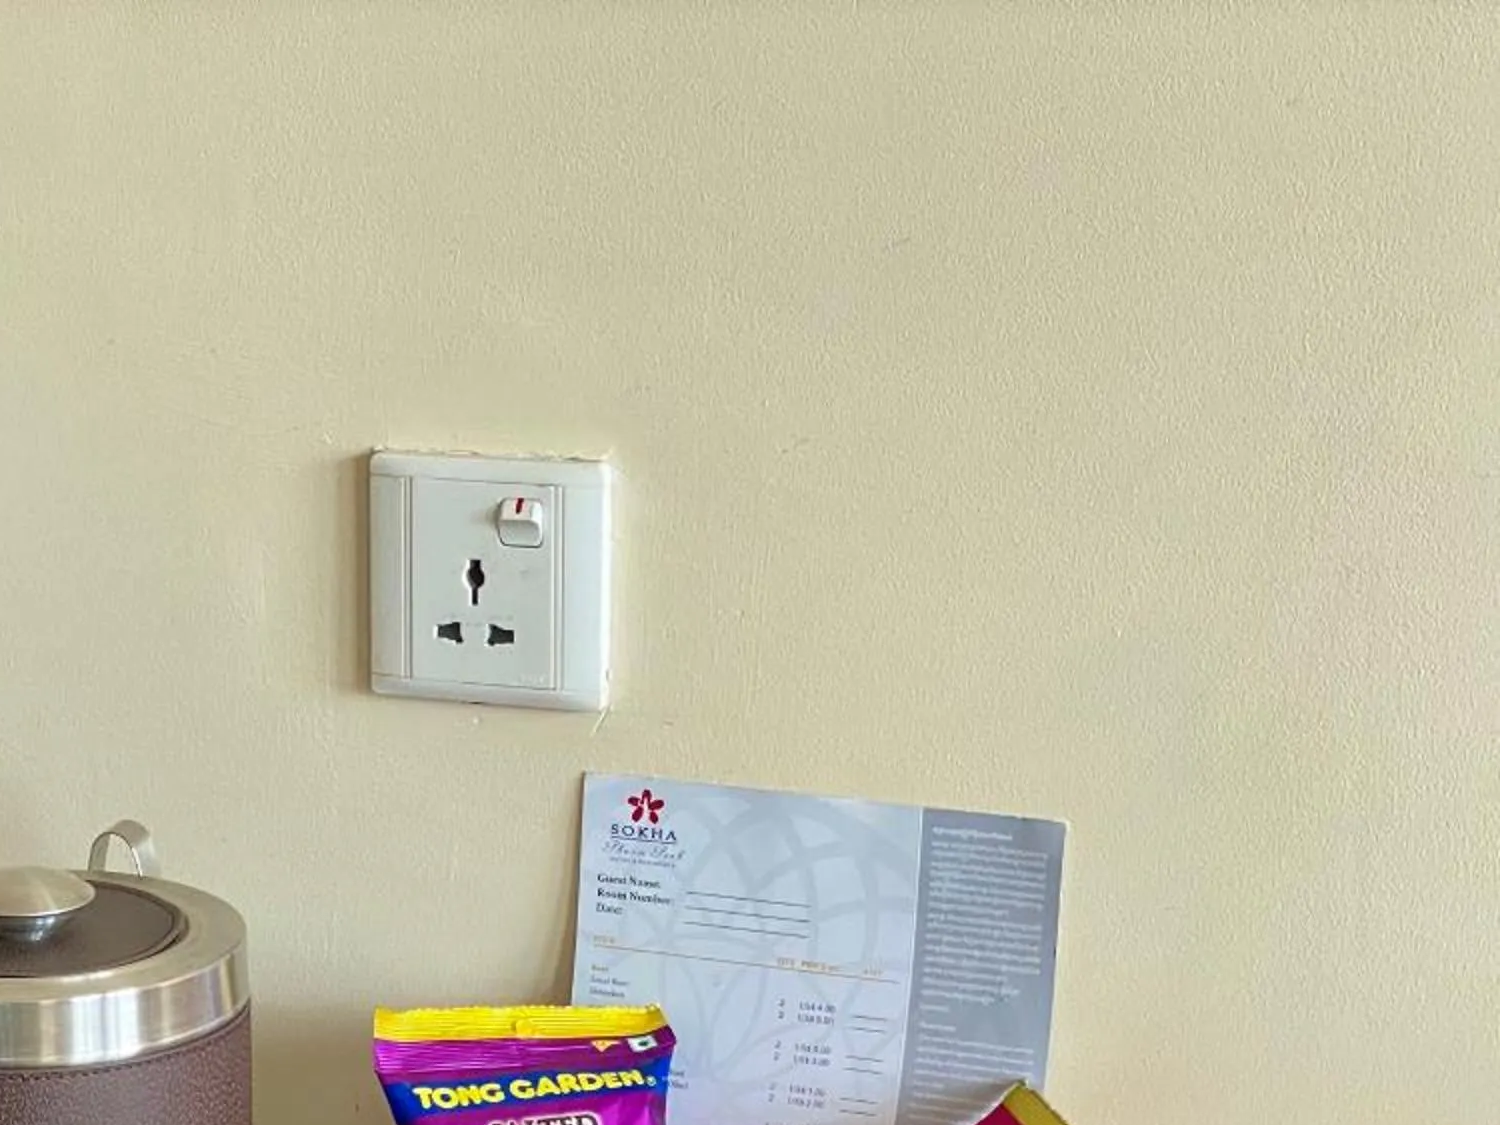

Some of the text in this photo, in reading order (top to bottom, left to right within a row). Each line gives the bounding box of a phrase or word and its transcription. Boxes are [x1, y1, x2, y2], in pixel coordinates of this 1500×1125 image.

[610, 823, 678, 842] SOKHA
[412, 1069, 645, 1110] TONG GARDEN
